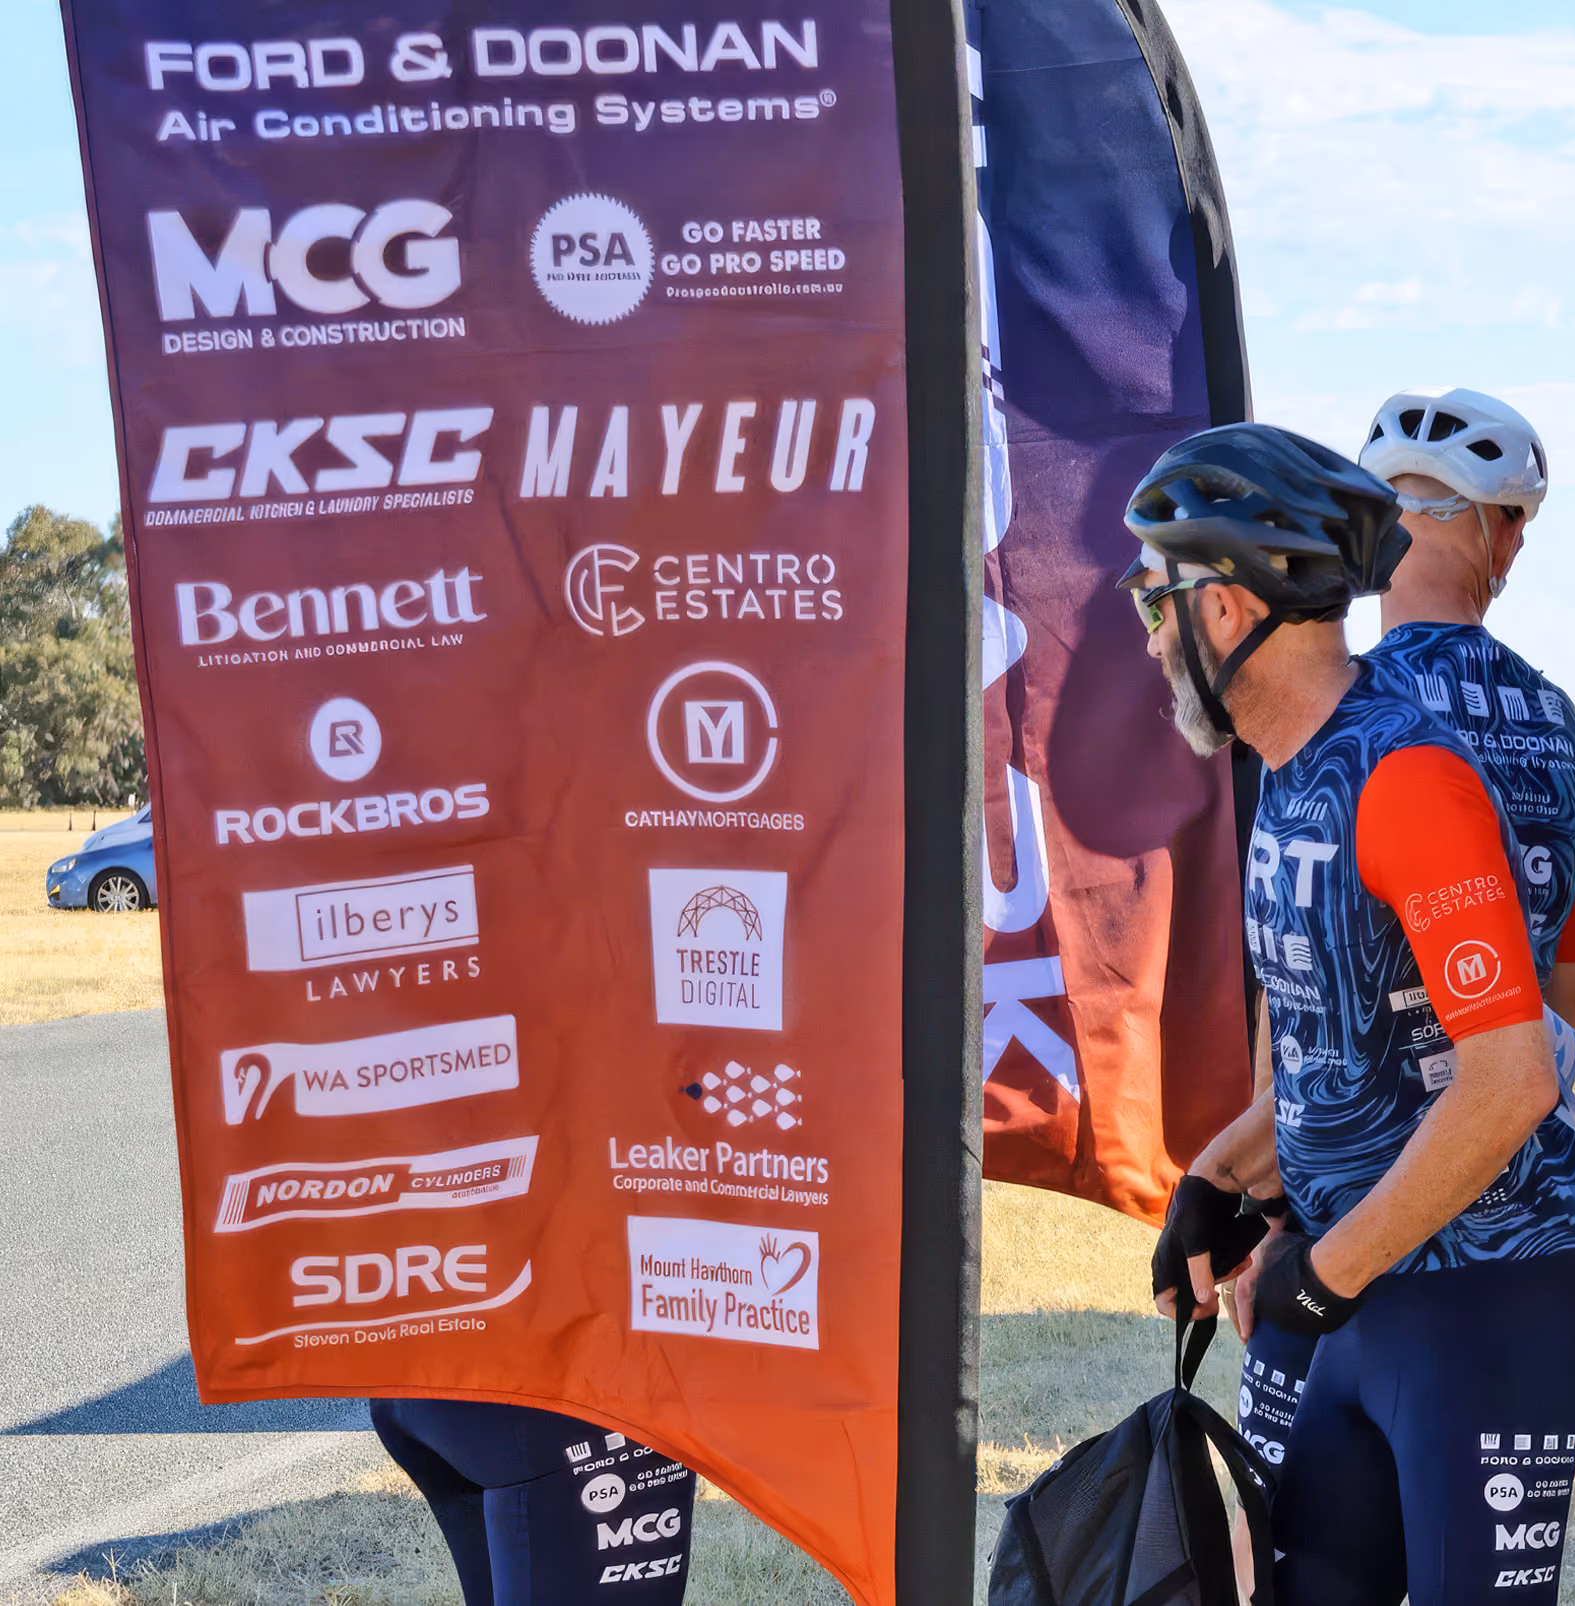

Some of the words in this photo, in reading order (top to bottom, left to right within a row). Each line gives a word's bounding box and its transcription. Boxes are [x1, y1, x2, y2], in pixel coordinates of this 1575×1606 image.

[145, 38, 365, 91] FORD
[391, 32, 452, 82] &
[473, 19, 818, 76] DOONAN
[157, 110, 236, 141] Air
[255, 97, 576, 139] Conditioning
[682, 221, 723, 243] GO
[731, 216, 821, 242] FASTER
[147, 198, 461, 321] MCG
[551, 232, 635, 267] PSA
[661, 254, 701, 275] GO
[710, 251, 761, 274] PRO
[770, 247, 846, 272] SPEED
[163, 329, 253, 355] DESIGN
[261, 328, 275, 347] &
[279, 317, 465, 347] CONSTRUCTION
[148, 407, 494, 503] CKSC
[520, 398, 875, 497] MAYEUR
[144, 506, 244, 527] COMMERCIAL
[250, 502, 302, 520] KITCHEN
[306, 501, 316, 516] &
[318, 496, 379, 515] LAUNDRY
[383, 489, 474, 510] SPECIALISTS
[653, 553, 836, 585] CENTRO
[174, 566, 488, 646] Bennett
[655, 589, 844, 621] ESTATES
[198, 650, 288, 667] LITIGATION
[295, 647, 321, 660] AND
[326, 637, 424, 656] COMMERCIAL
[431, 634, 463, 647] LAW
[216, 783, 490, 844] ROCKBROS
[625, 810, 805, 831] CATHAYMORTGAGES
[1249, 827, 1339, 907] RT
[1427, 875, 1498, 905] CENTRO
[1432, 887, 1506, 919] ESTATES
[316, 900, 459, 941] ilberys
[306, 957, 481, 1002] LAWYERS
[676, 949, 760, 977] TRESTLE
[681, 979, 760, 1009] DIGITAL
[303, 1070, 349, 1092] WA
[357, 1043, 511, 1088] SPORTSMED
[411, 1164, 501, 1188] CYLINDERS
[609, 1136, 709, 1171] Leaker
[716, 1141, 828, 1183] Partners
[256, 1172, 395, 1208] NORDON
[613, 1174, 682, 1193] Corporate
[686, 1178, 708, 1193] and
[711, 1179, 778, 1201] Commercial
[781, 1186, 828, 1206] Lawyers
[290, 1245, 487, 1307] SDRE
[640, 1254, 685, 1278] Mount
[691, 1257, 752, 1286] Hawthorn
[642, 1284, 717, 1332] Family
[724, 1292, 810, 1335] Practice
[294, 1334, 349, 1348] Steven
[355, 1327, 396, 1344] Davis
[400, 1322, 433, 1338] Real
[438, 1318, 486, 1332] Estate
[589, 1486, 619, 1501] PSA
[1490, 1487, 1518, 1498] PSA
[597, 1507, 681, 1550] MCG
[1495, 1521, 1560, 1550] MCG
[599, 1553, 682, 1584] CKSC
[1494, 1565, 1556, 1587] CKSC
